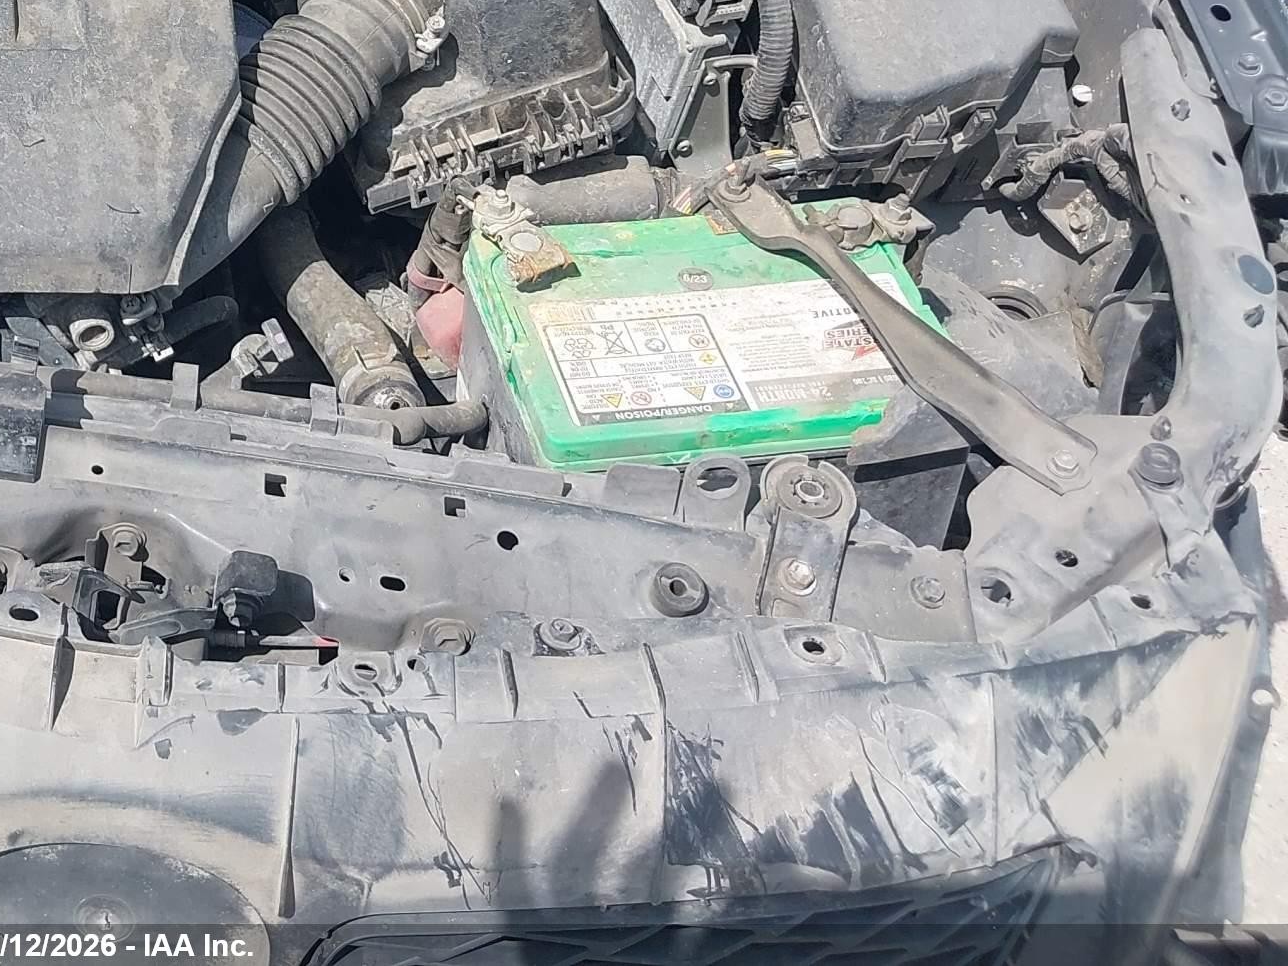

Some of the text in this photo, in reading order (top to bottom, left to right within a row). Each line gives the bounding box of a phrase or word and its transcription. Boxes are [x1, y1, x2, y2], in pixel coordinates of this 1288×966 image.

[811, 307, 851, 318] OTIVE
[825, 326, 869, 338] ERIES
[824, 336, 874, 348] STATE
[756, 386, 832, 402] 24-MONTH
[614, 404, 713, 420] DANGER/POISON
